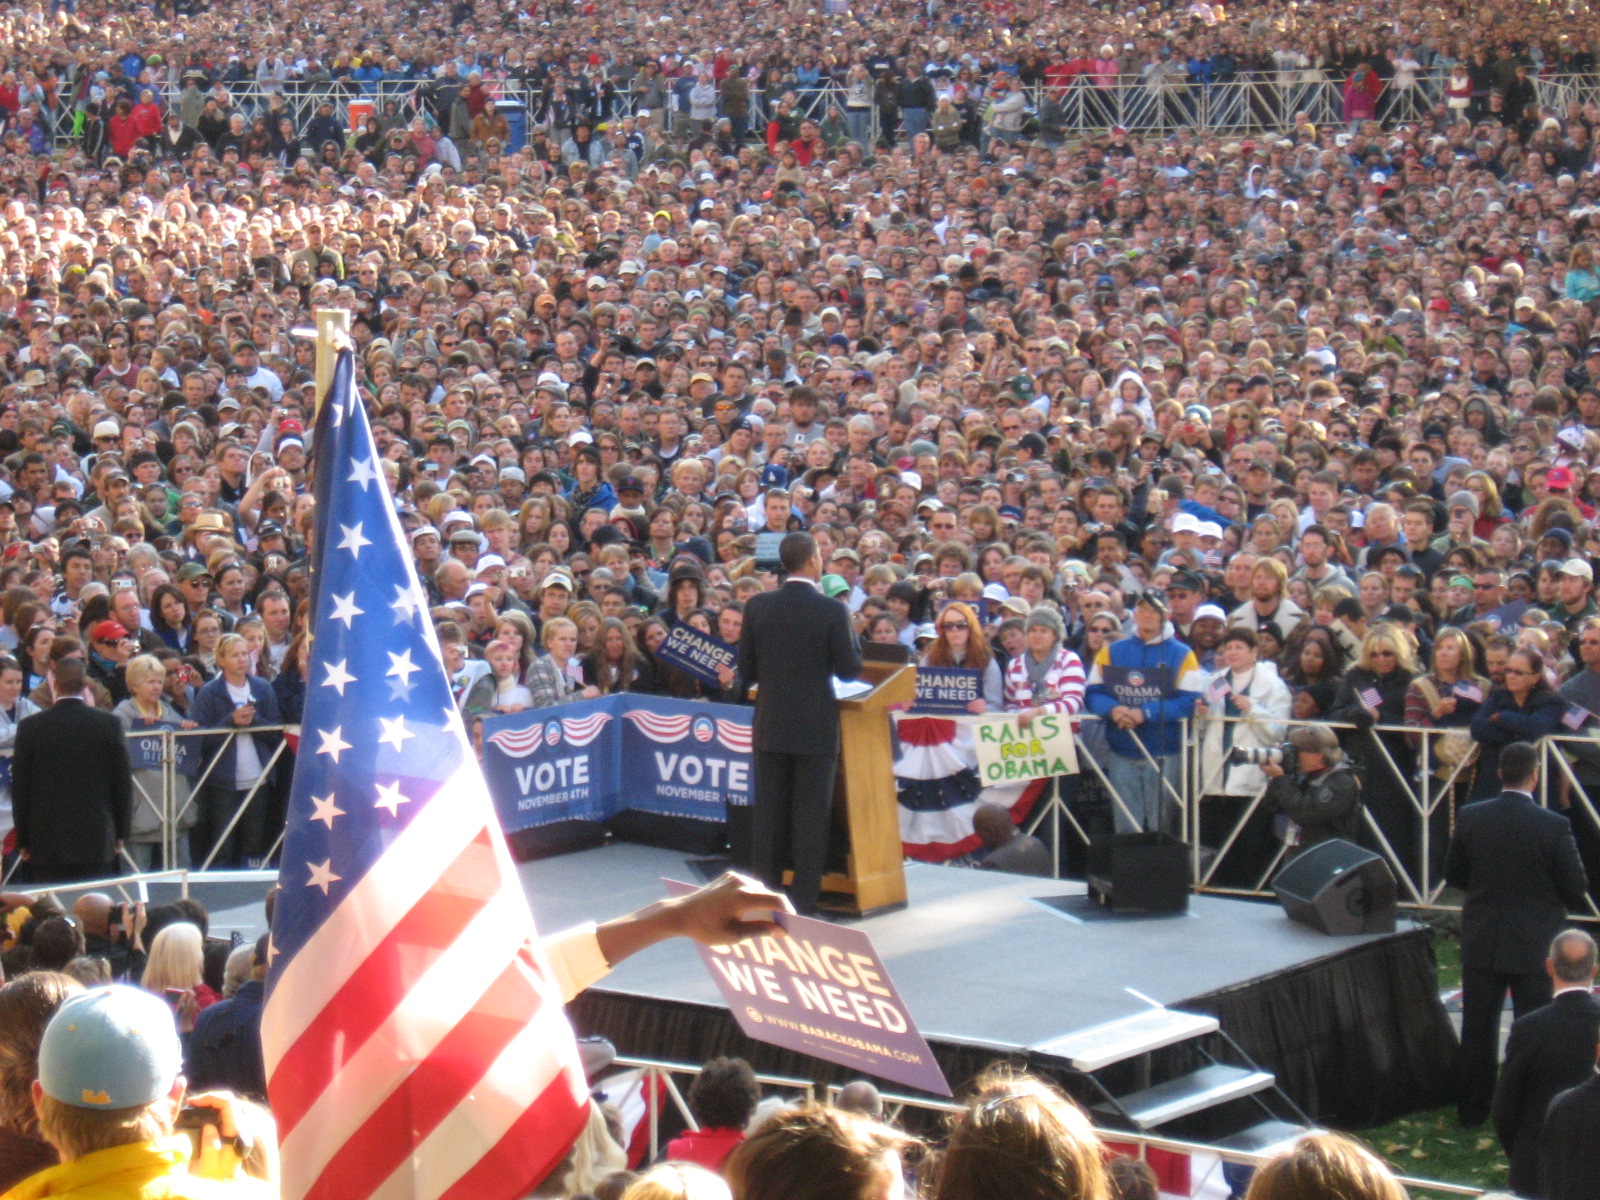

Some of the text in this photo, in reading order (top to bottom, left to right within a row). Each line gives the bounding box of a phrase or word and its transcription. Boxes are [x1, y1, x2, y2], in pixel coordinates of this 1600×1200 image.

[667, 637, 689, 655] WE
[689, 649, 721, 672] NEE
[673, 627, 734, 665] CHANGE
[938, 688, 977, 700] NEED
[1114, 685, 1161, 697] OBAMA
[1001, 739, 1046, 760] FOR
[515, 754, 590, 795] VOTE
[655, 751, 750, 792] VOTE
[987, 757, 1069, 780] OBAMA
[517, 787, 590, 811] NOVEMBER 4TH
[656, 784, 720, 803] NOVEMBER
[710, 936, 891, 997] HANGE
[712, 957, 908, 1034] WE NEED
